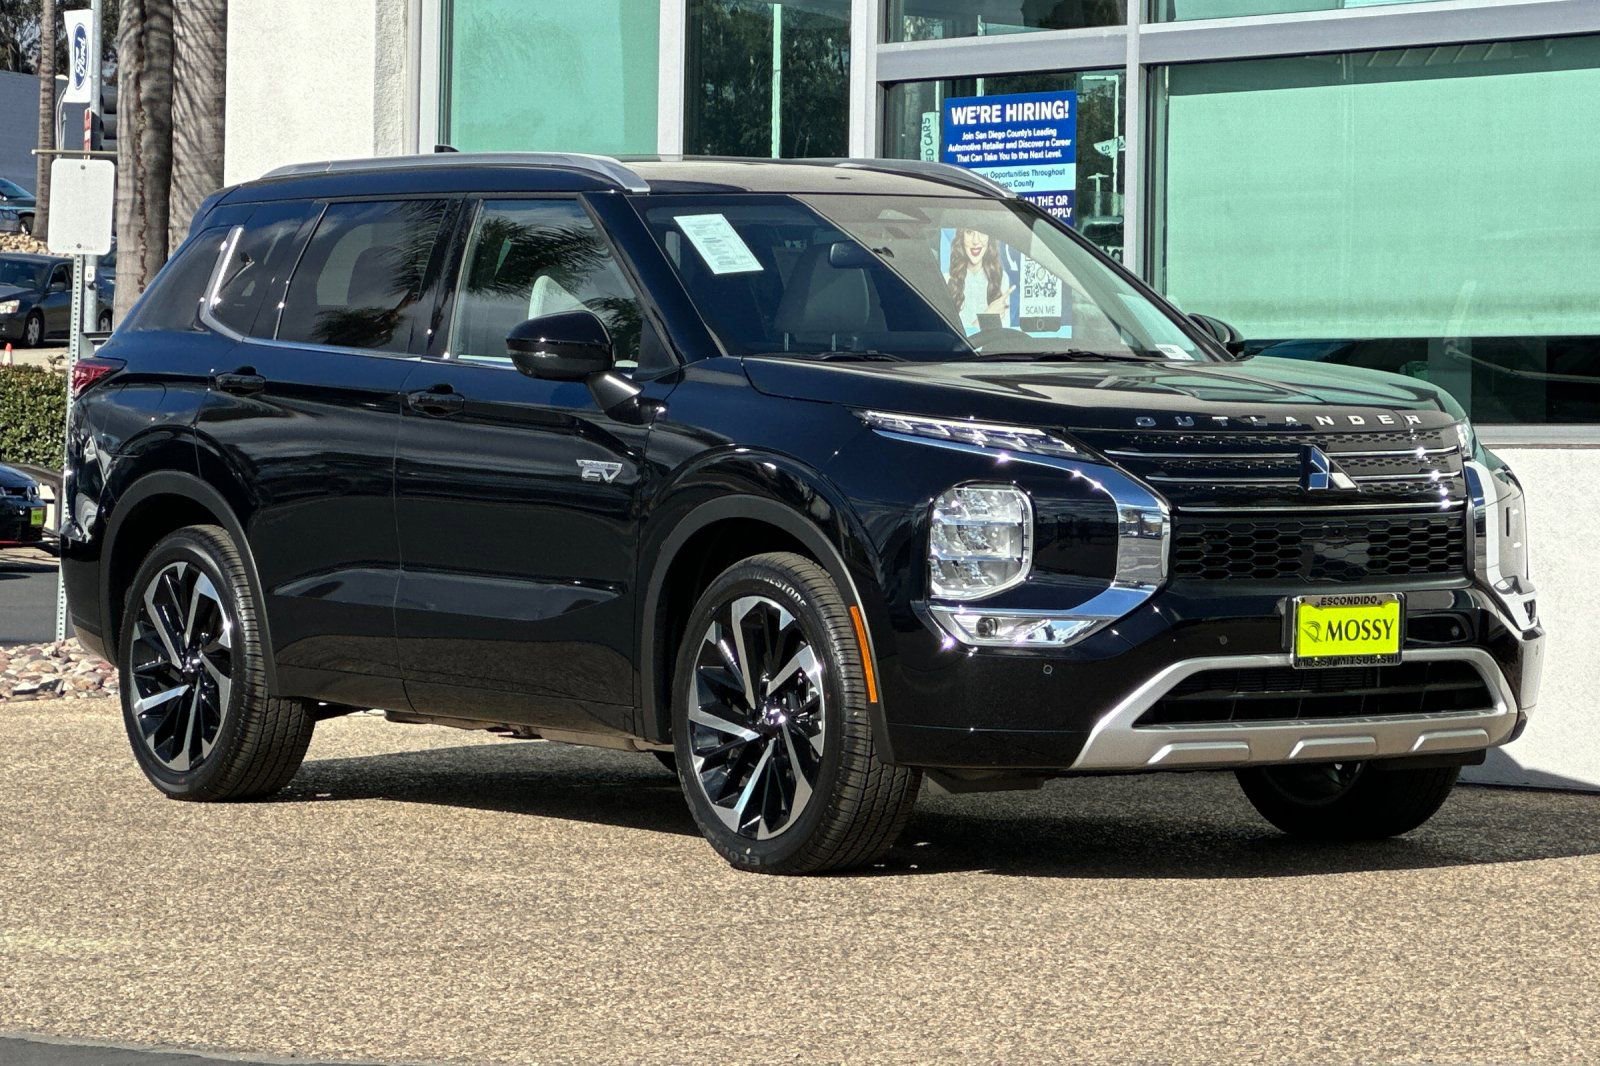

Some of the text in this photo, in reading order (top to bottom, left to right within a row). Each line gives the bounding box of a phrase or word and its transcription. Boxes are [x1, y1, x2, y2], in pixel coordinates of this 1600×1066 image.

[75, 36, 86, 77] Ford
[951, 100, 1069, 125] WE'RE HIRING!
[922, 117, 933, 146] CARS
[962, 127, 1057, 140] Join San Diego County's Leading
[948, 142, 981, 152] Automotive
[982, 141, 1005, 150] Retailer
[1005, 140, 1017, 149] and
[1018, 139, 1044, 148] Discover
[1050, 137, 1071, 147] Career
[957, 149, 1062, 163] That Can Take You to the Next Level.
[990, 169, 1030, 179] Opportunities
[1031, 167, 1066, 178] Throughout
[1013, 179, 1035, 188] County
[1036, 195, 1054, 207] THE
[1055, 195, 1068, 206] QR
[1025, 304, 1056, 315] SCAN ME
[1135, 414, 1422, 428] OUTLANDER
[581, 467, 621, 484] EV
[1321, 595, 1379, 606] ESCONDIDO
[1325, 618, 1395, 642] MOSSY
